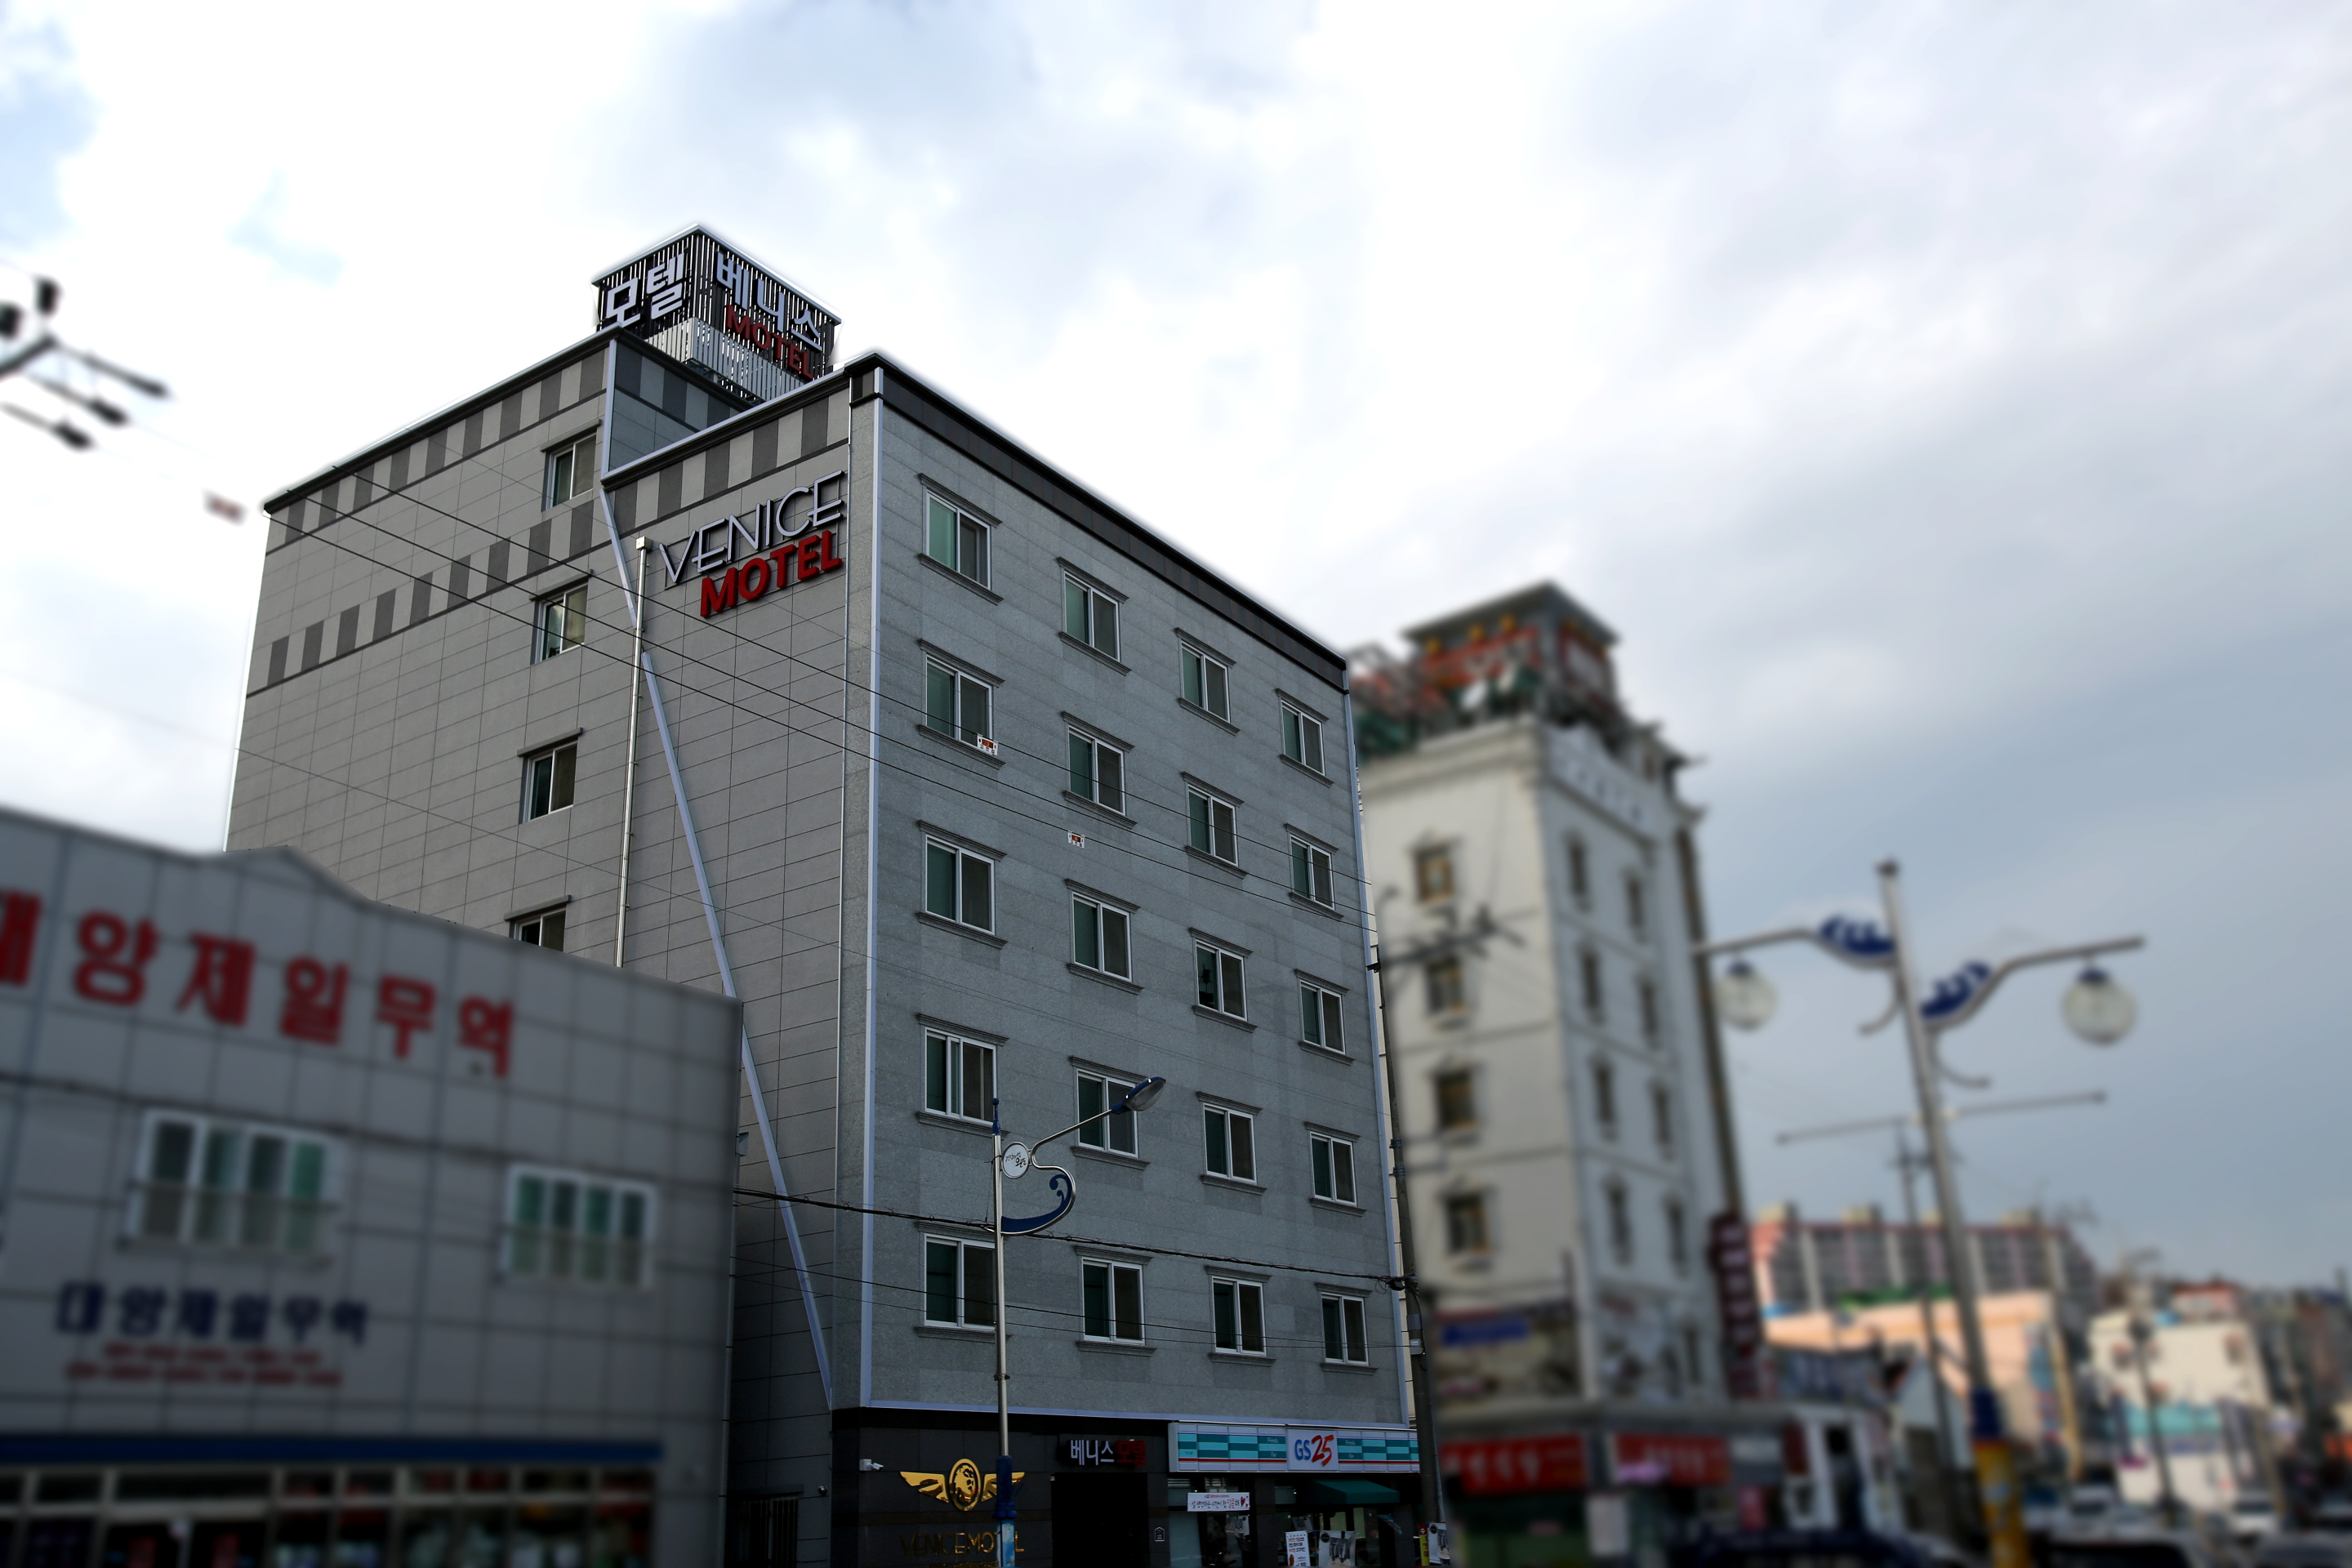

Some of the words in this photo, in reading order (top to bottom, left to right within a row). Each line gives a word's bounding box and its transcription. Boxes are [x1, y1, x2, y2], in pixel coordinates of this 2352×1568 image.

[605, 252, 684, 326] 모텔
[716, 251, 822, 352] 베니스
[726, 305, 813, 380] MOTEL
[659, 470, 844, 582] VENICE
[700, 530, 842, 618] MOTEL
[1070, 1440, 1115, 1466] 베니스
[1115, 1441, 1146, 1467] 모텔
[1294, 1434, 1334, 1467] GS25
